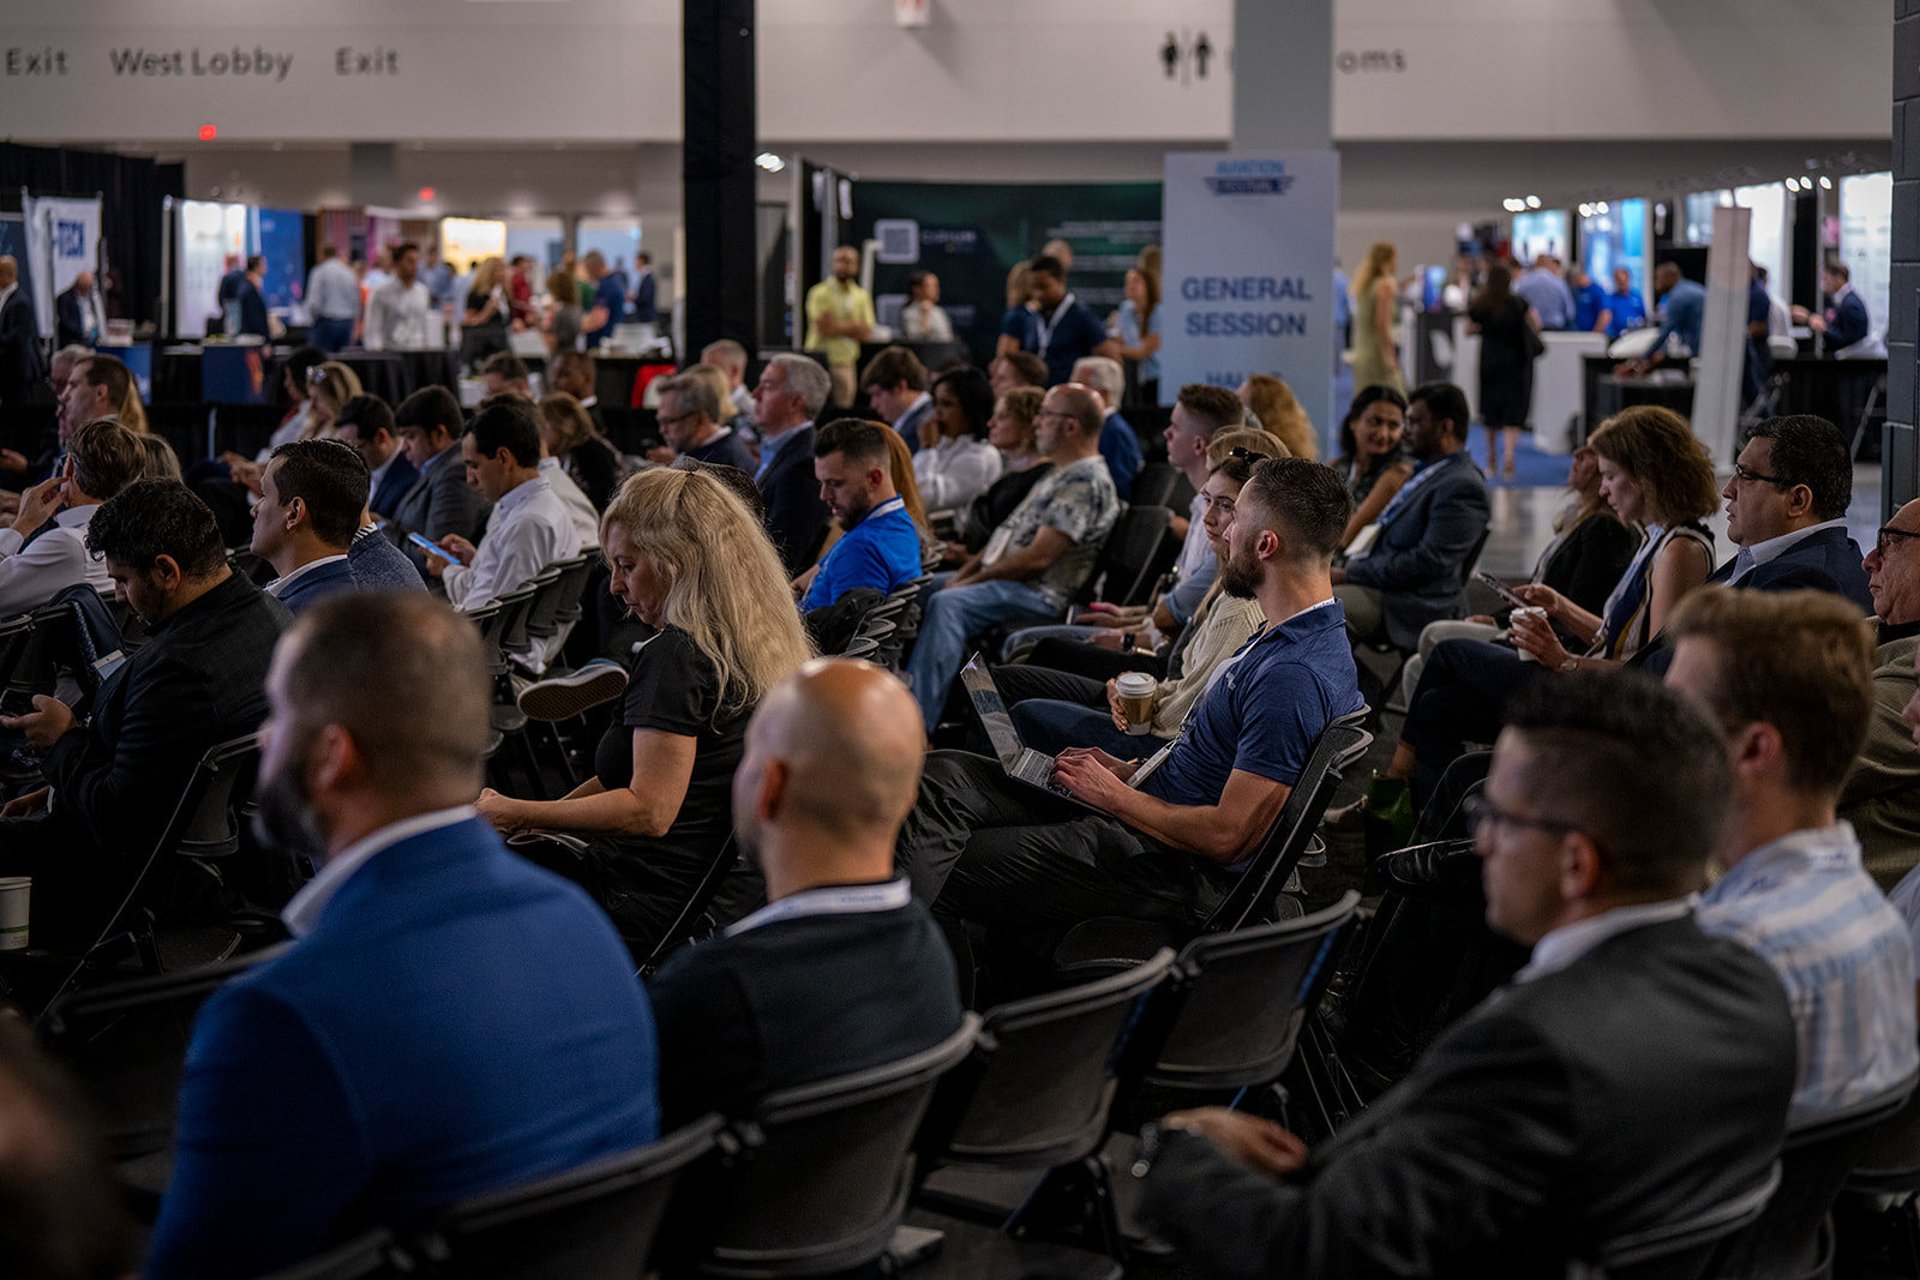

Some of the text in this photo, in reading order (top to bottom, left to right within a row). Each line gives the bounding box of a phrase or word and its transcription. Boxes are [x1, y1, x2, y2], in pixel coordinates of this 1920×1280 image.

[6, 47, 68, 76] Exit
[110, 46, 294, 82] West Lobby
[335, 46, 398, 76] Exit
[1181, 276, 1312, 300] GENERAL
[1186, 312, 1306, 336] SESSION
